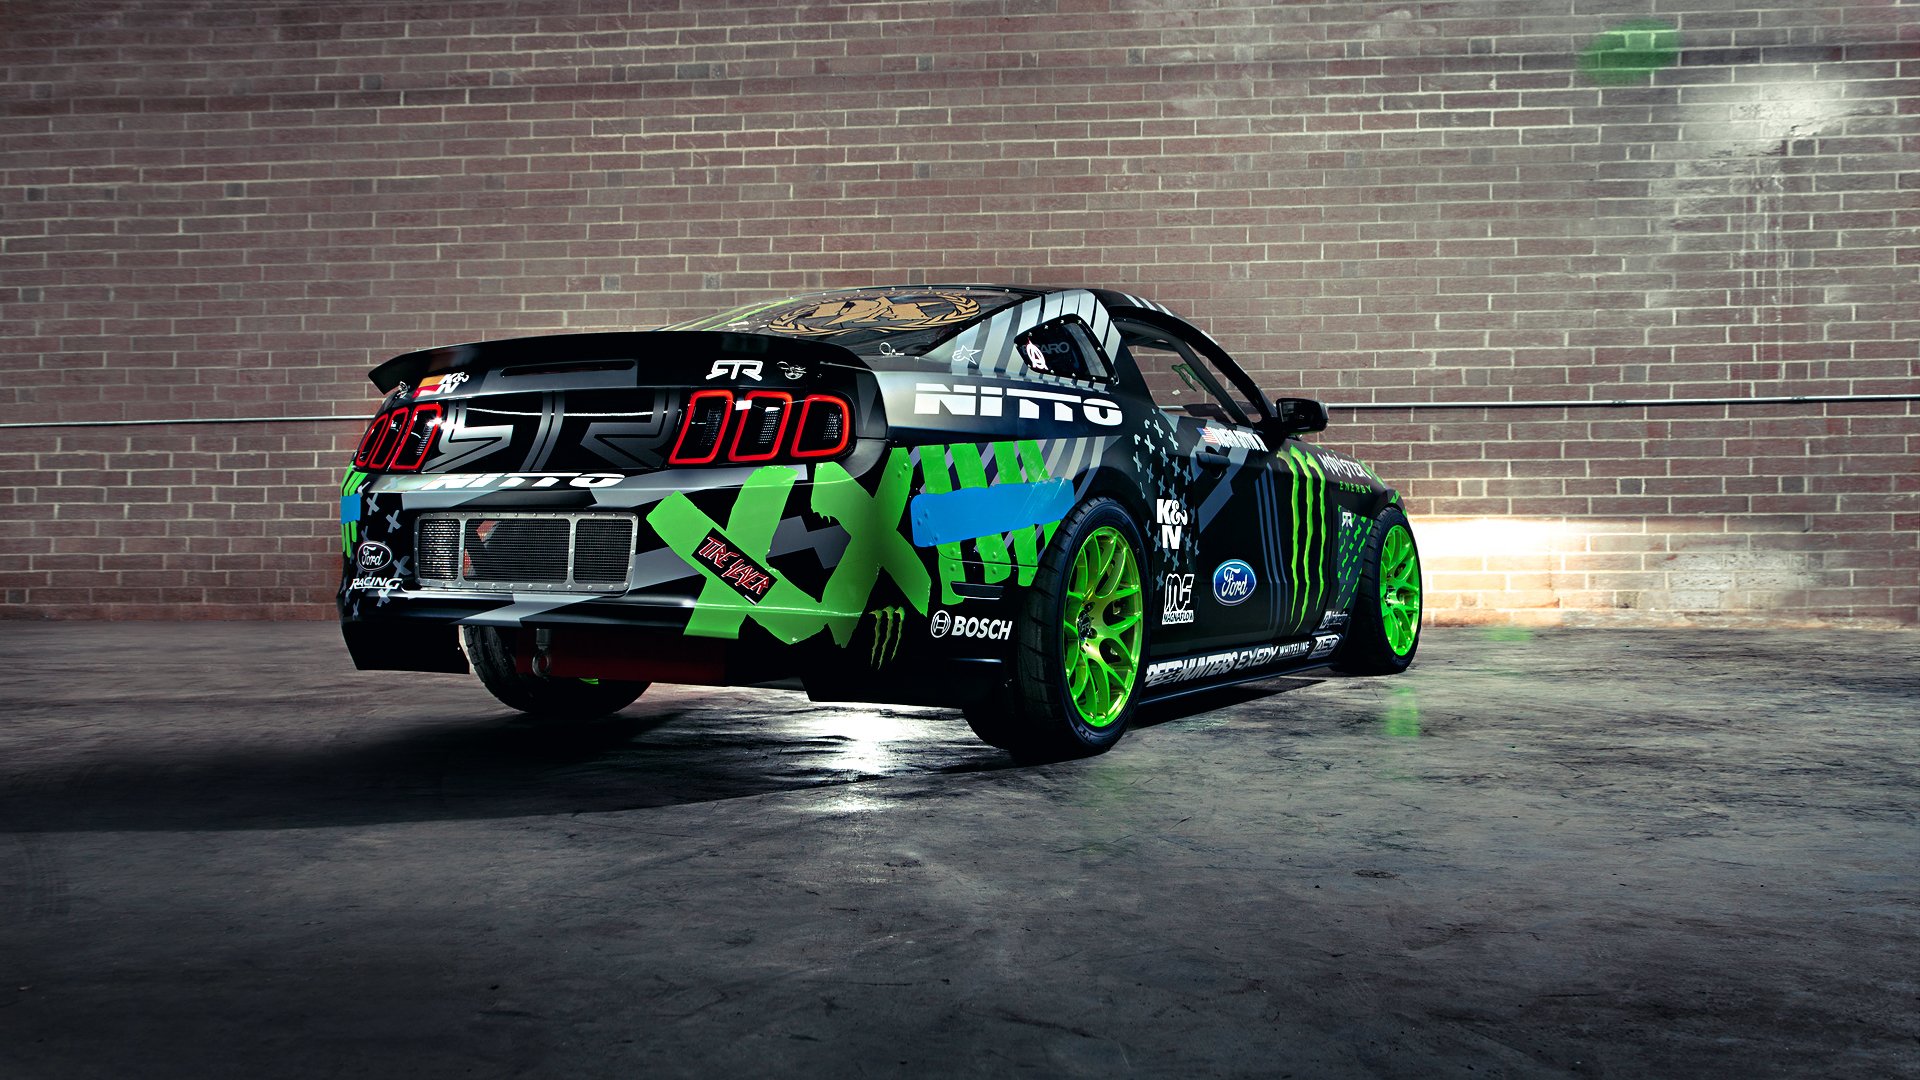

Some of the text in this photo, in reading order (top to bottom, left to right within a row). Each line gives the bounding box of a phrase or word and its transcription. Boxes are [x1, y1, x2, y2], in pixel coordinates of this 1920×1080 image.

[914, 383, 1123, 426] NITTO
[1340, 481, 1372, 494] ENERGY
[698, 536, 740, 569] TIRE
[349, 577, 402, 590] RACING
[1221, 567, 1248, 597] Ford
[951, 615, 1013, 641] BOSCH
[1145, 651, 1238, 688] PEEDHUNTERS
[1234, 646, 1280, 669] EXEDY
